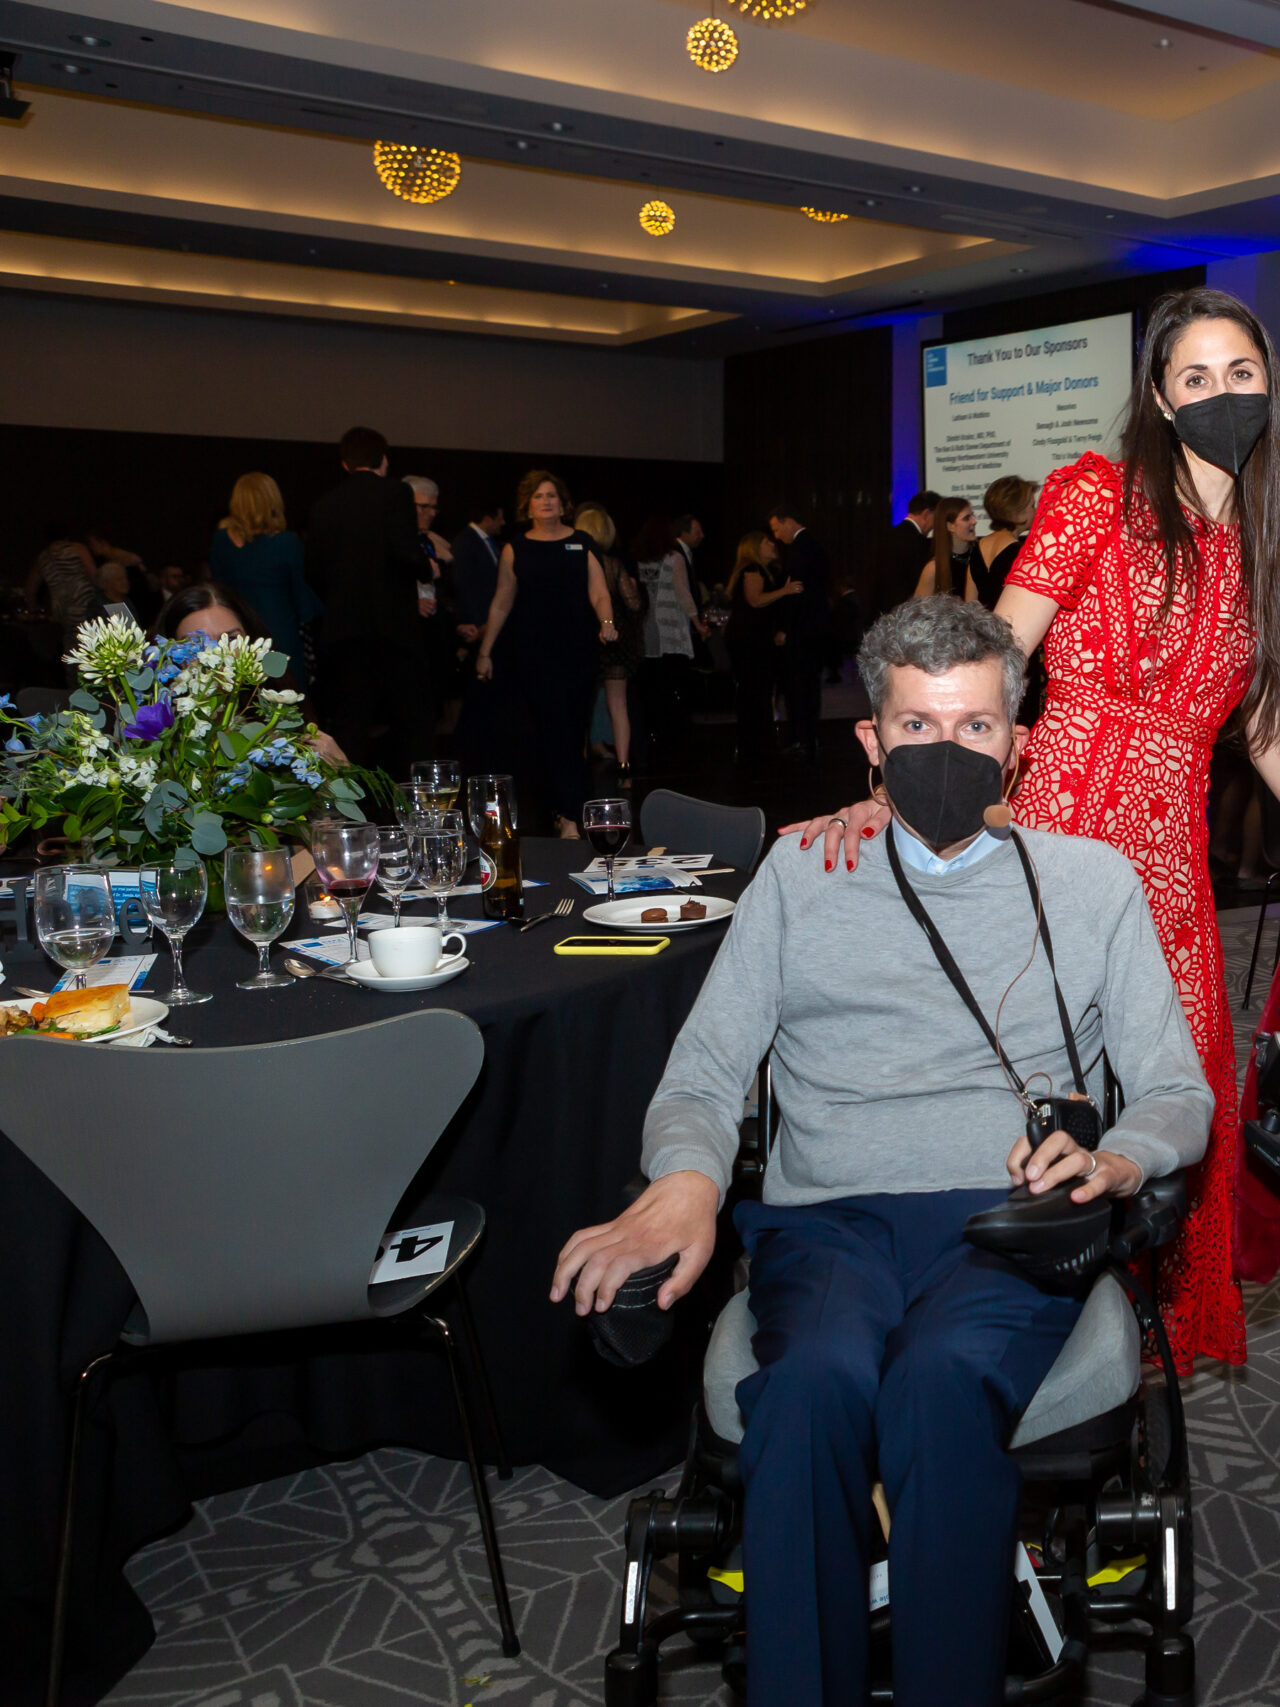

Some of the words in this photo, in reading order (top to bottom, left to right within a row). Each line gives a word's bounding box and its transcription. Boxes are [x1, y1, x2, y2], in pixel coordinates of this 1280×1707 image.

[967, 353, 994, 366] Thank
[994, 348, 1012, 360] You
[1014, 347, 1023, 359] to
[1025, 343, 1042, 357] Our
[1043, 337, 1088, 358] Sponsors
[950, 389, 975, 405] Friend
[976, 388, 989, 400] for
[991, 384, 1025, 402] Support
[1027, 382, 1033, 395] &
[1036, 379, 1062, 396] Major
[1064, 375, 1099, 391] Donors
[375, 1235, 444, 1263] 4
